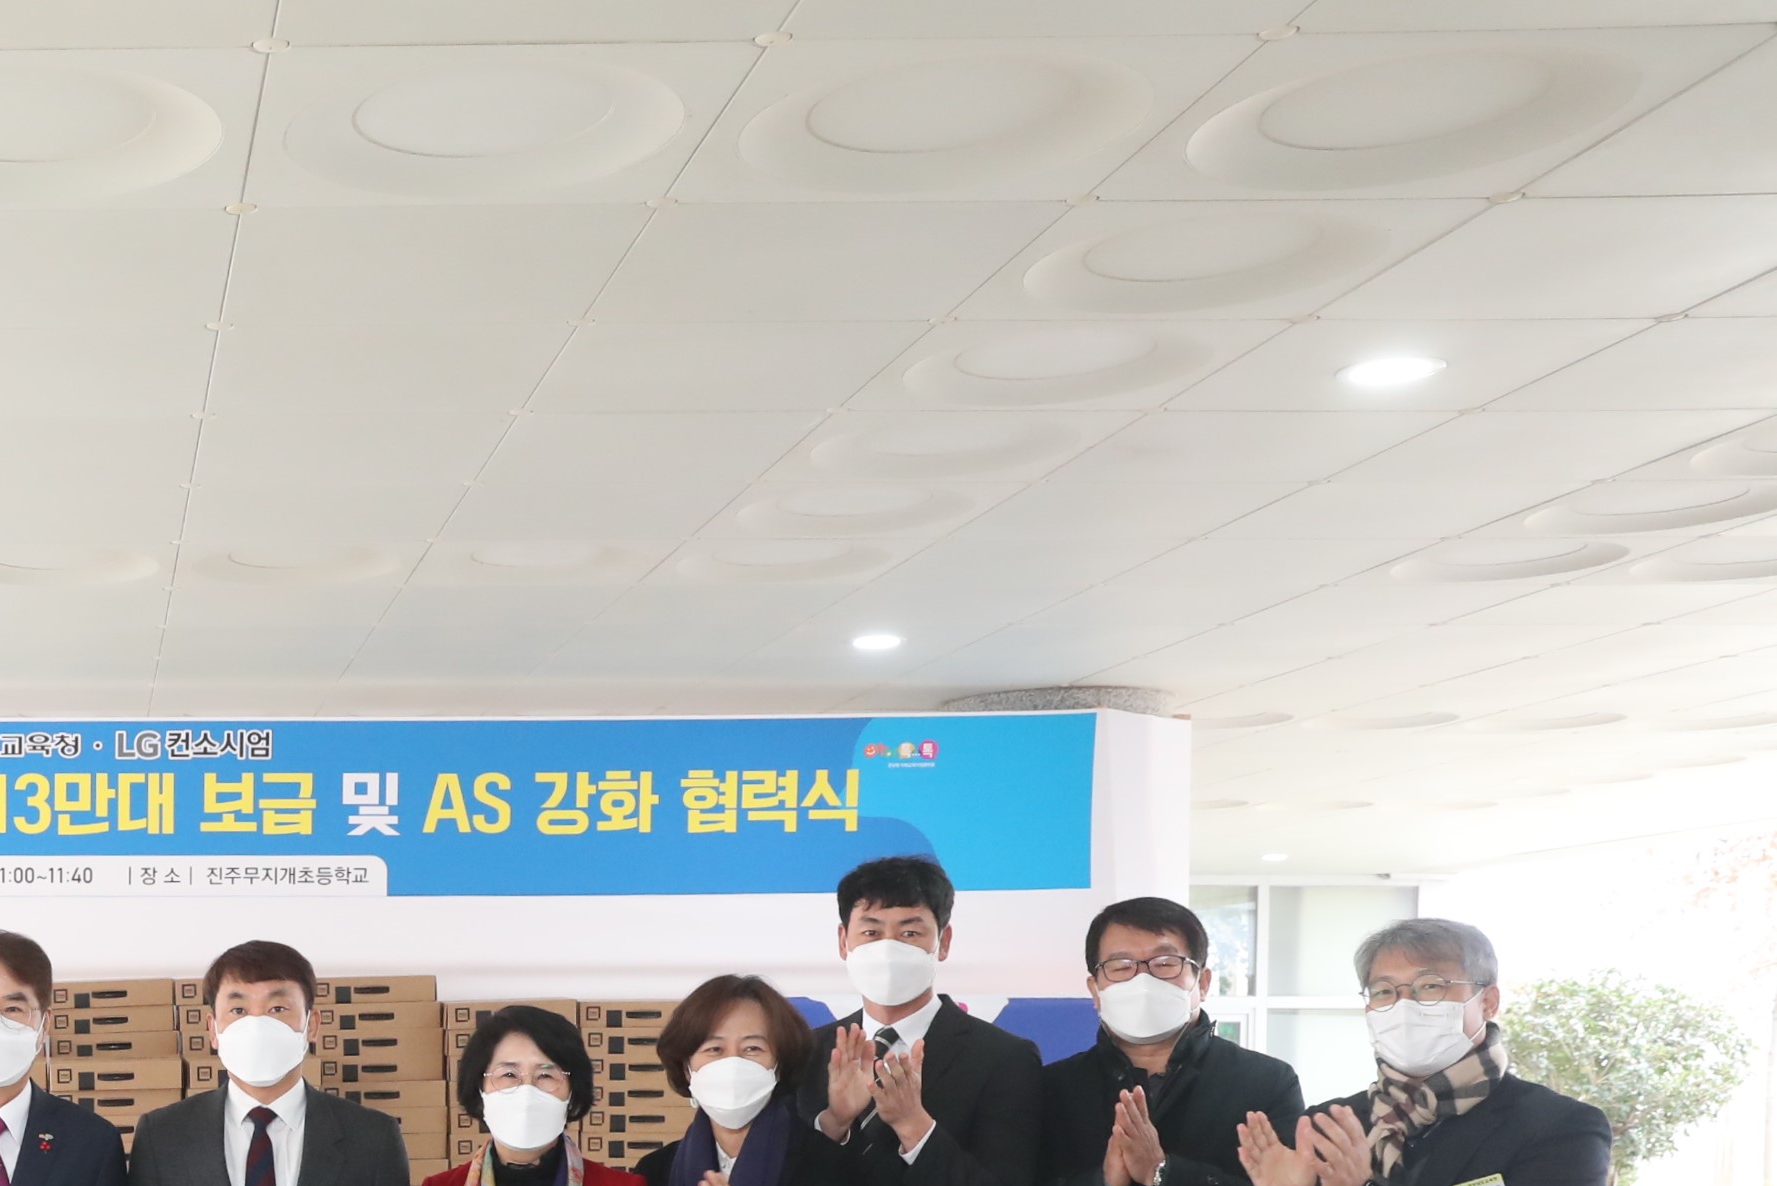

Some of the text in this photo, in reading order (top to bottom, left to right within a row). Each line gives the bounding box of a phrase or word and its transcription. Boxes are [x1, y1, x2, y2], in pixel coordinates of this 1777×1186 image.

[200, 772, 317, 835] 보급
[342, 772, 401, 836] 및
[423, 772, 511, 833] AS
[535, 770, 659, 835] 강화
[681, 769, 859, 833] 협력식
[207, 866, 369, 885] 진주무지개초등학교
